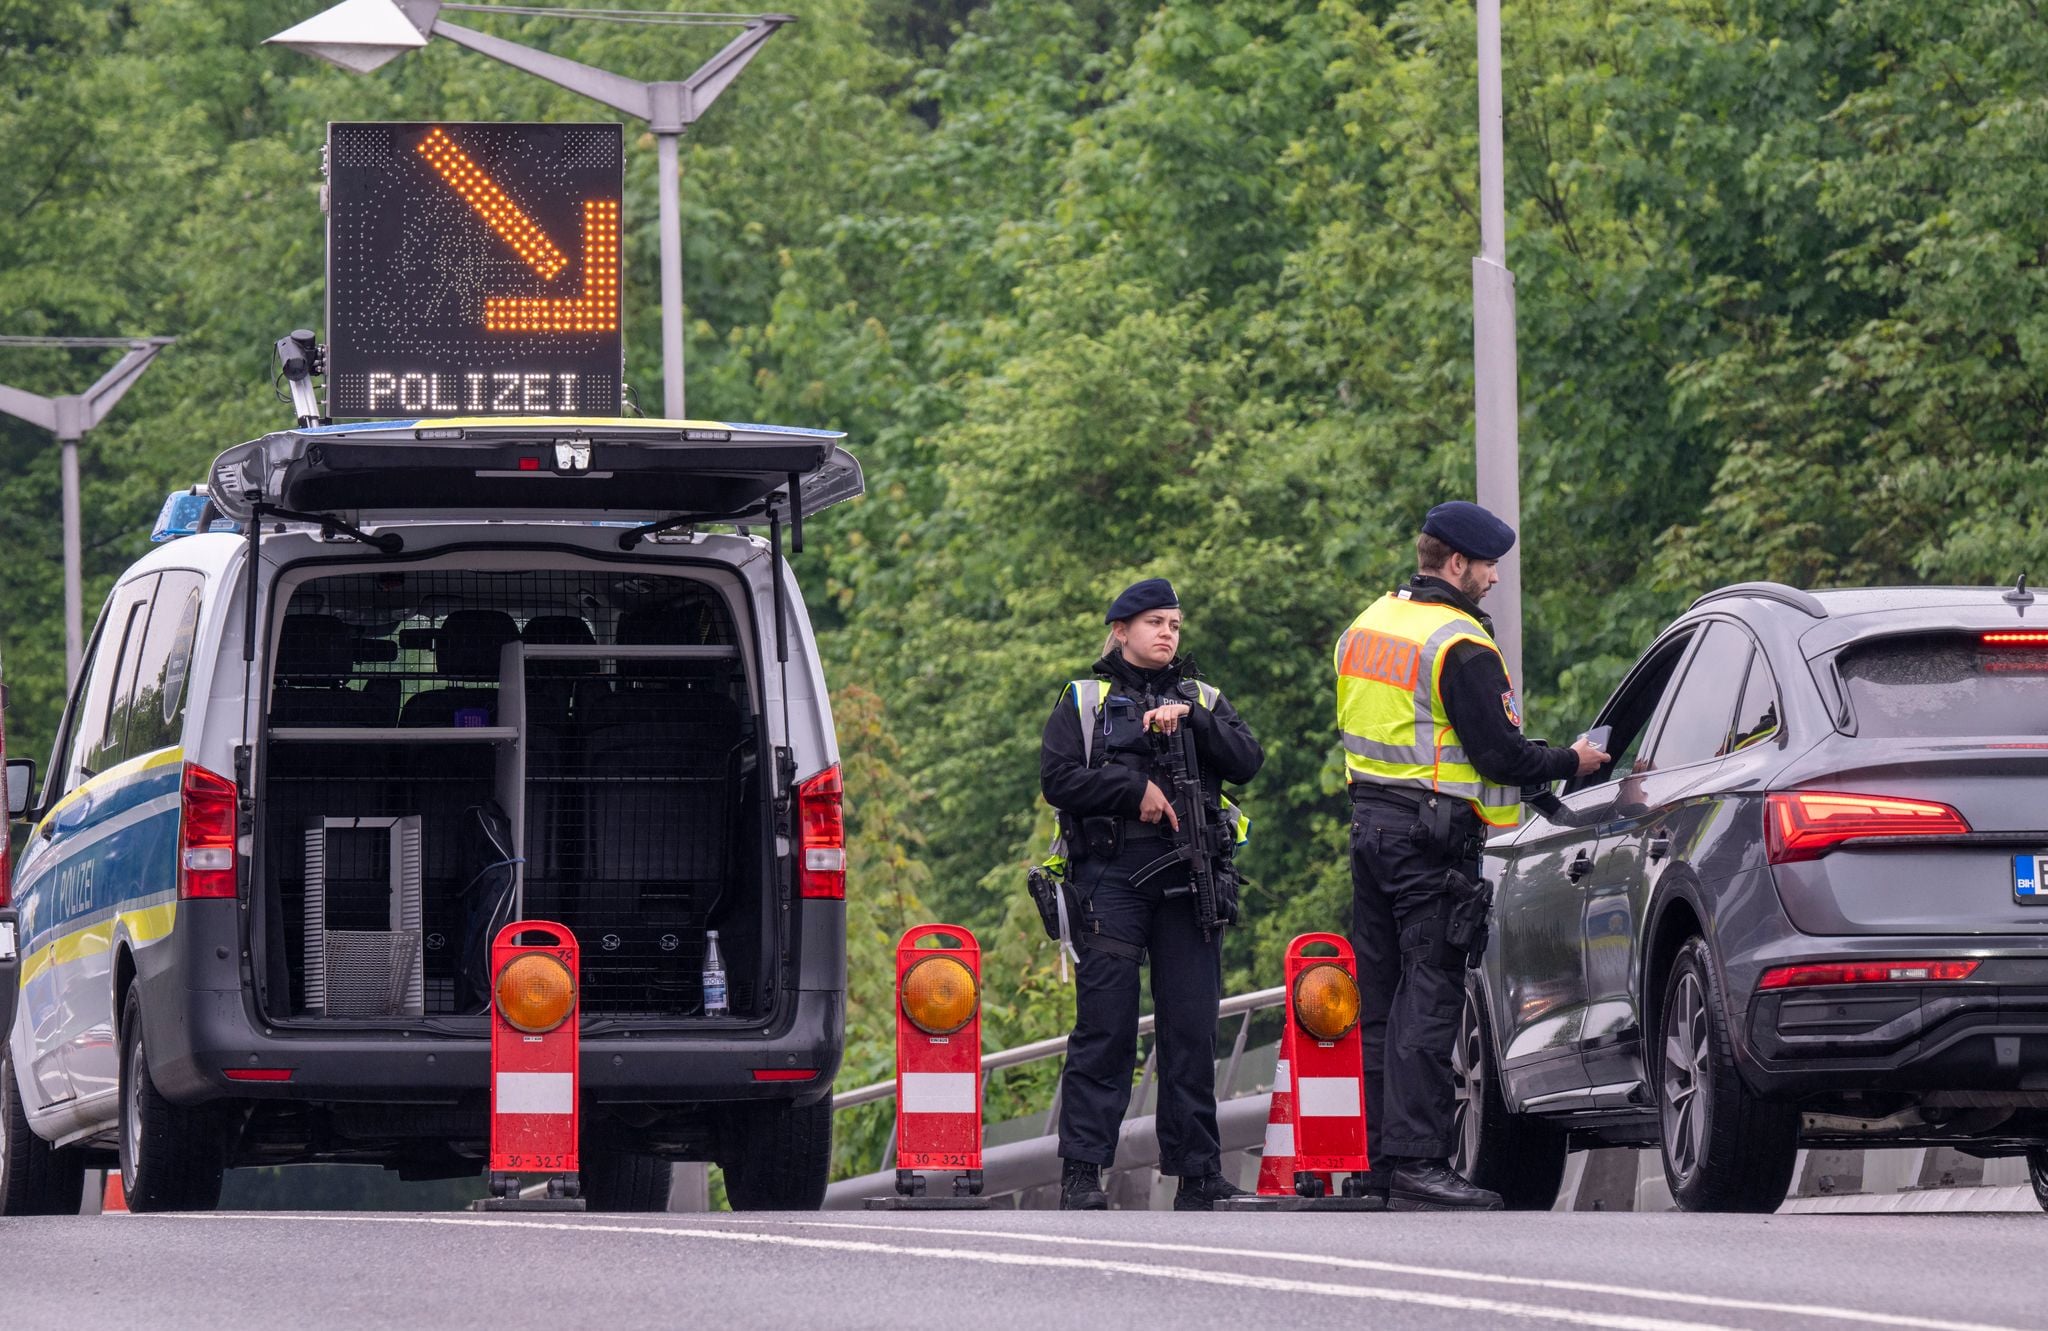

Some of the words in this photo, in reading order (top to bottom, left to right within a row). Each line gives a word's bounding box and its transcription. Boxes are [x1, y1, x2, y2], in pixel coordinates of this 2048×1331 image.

[369, 373, 576, 411] POLIZEI
[1351, 631, 1417, 684] OLIZEI
[59, 858, 95, 920] POLIZEI
[2017, 879, 2035, 888] BIH
